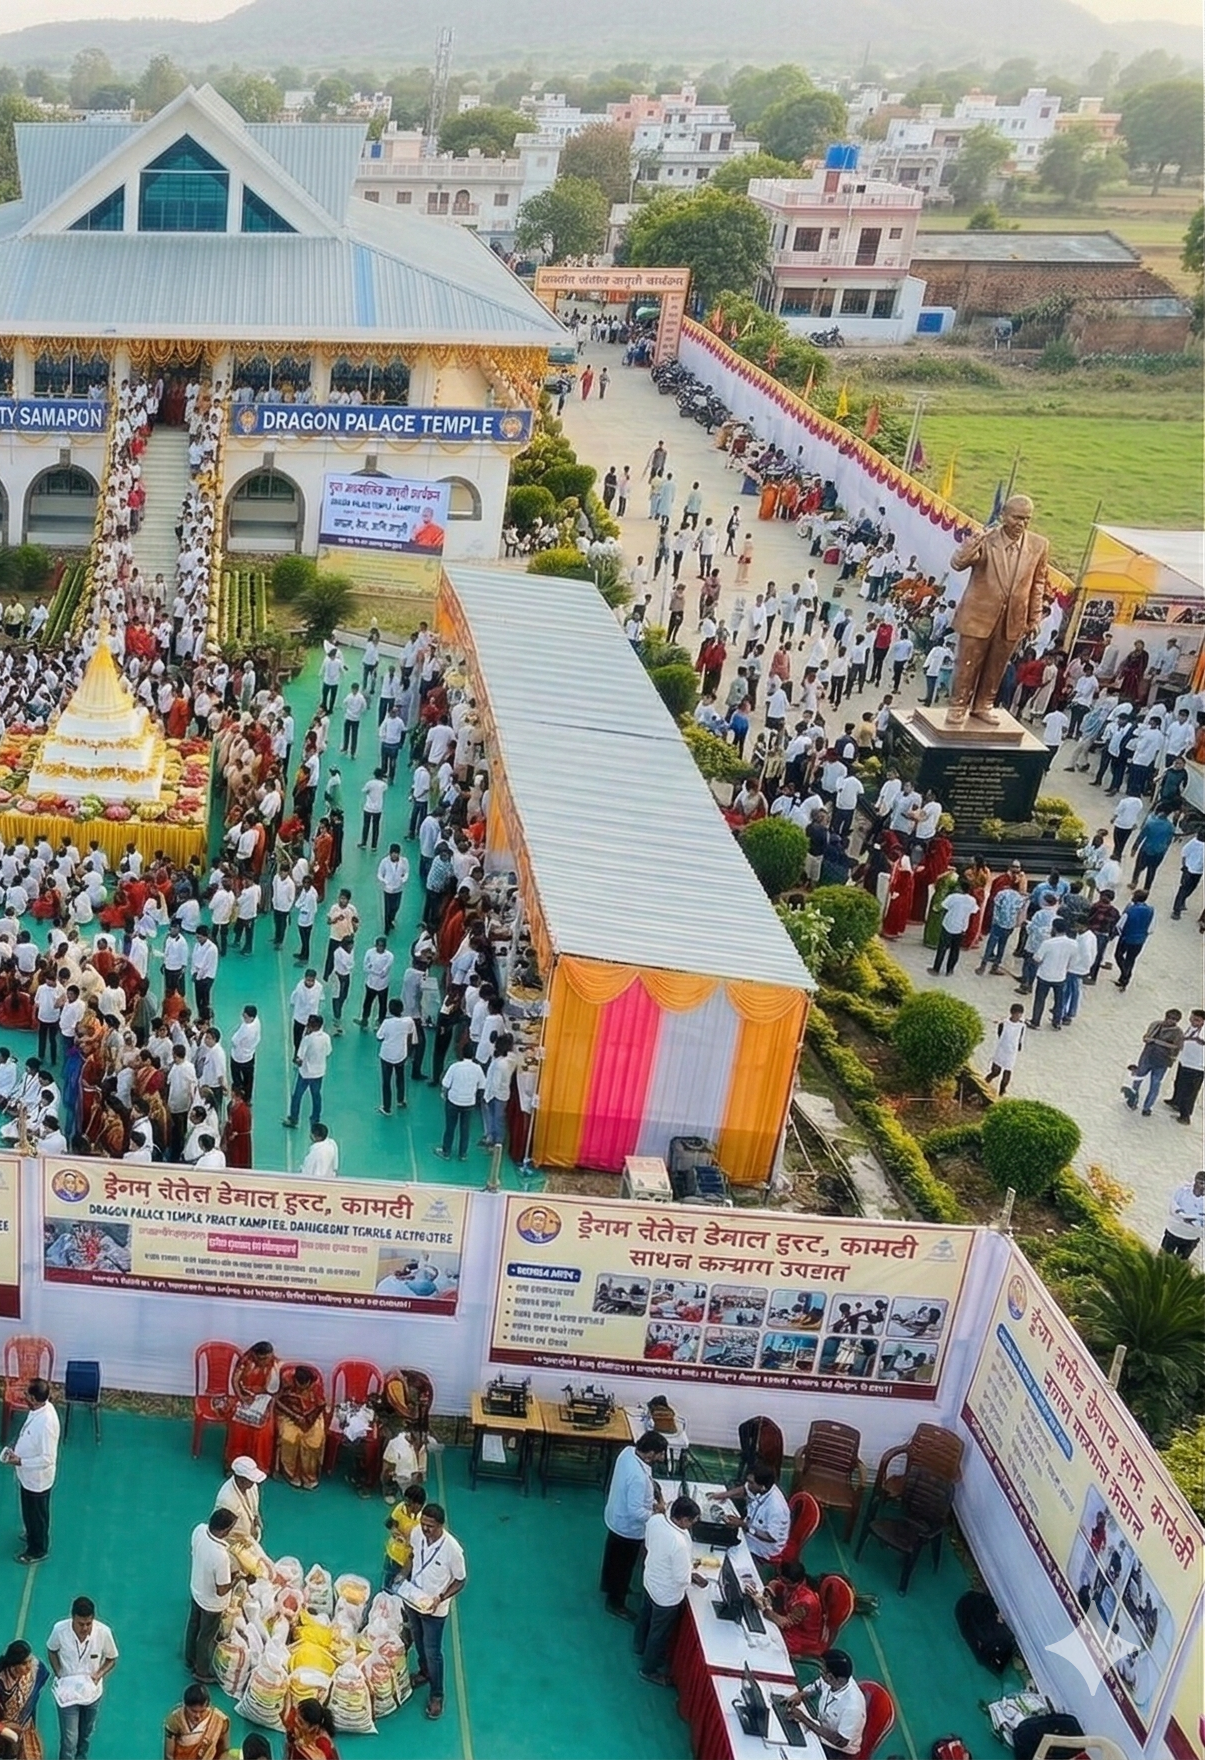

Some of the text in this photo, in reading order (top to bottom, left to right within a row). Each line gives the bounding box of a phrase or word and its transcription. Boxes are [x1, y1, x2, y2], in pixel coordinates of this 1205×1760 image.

[20, 406, 102, 428] SAMAPON
[262, 411, 494, 435] DRAGON PALACE TEMPLE
